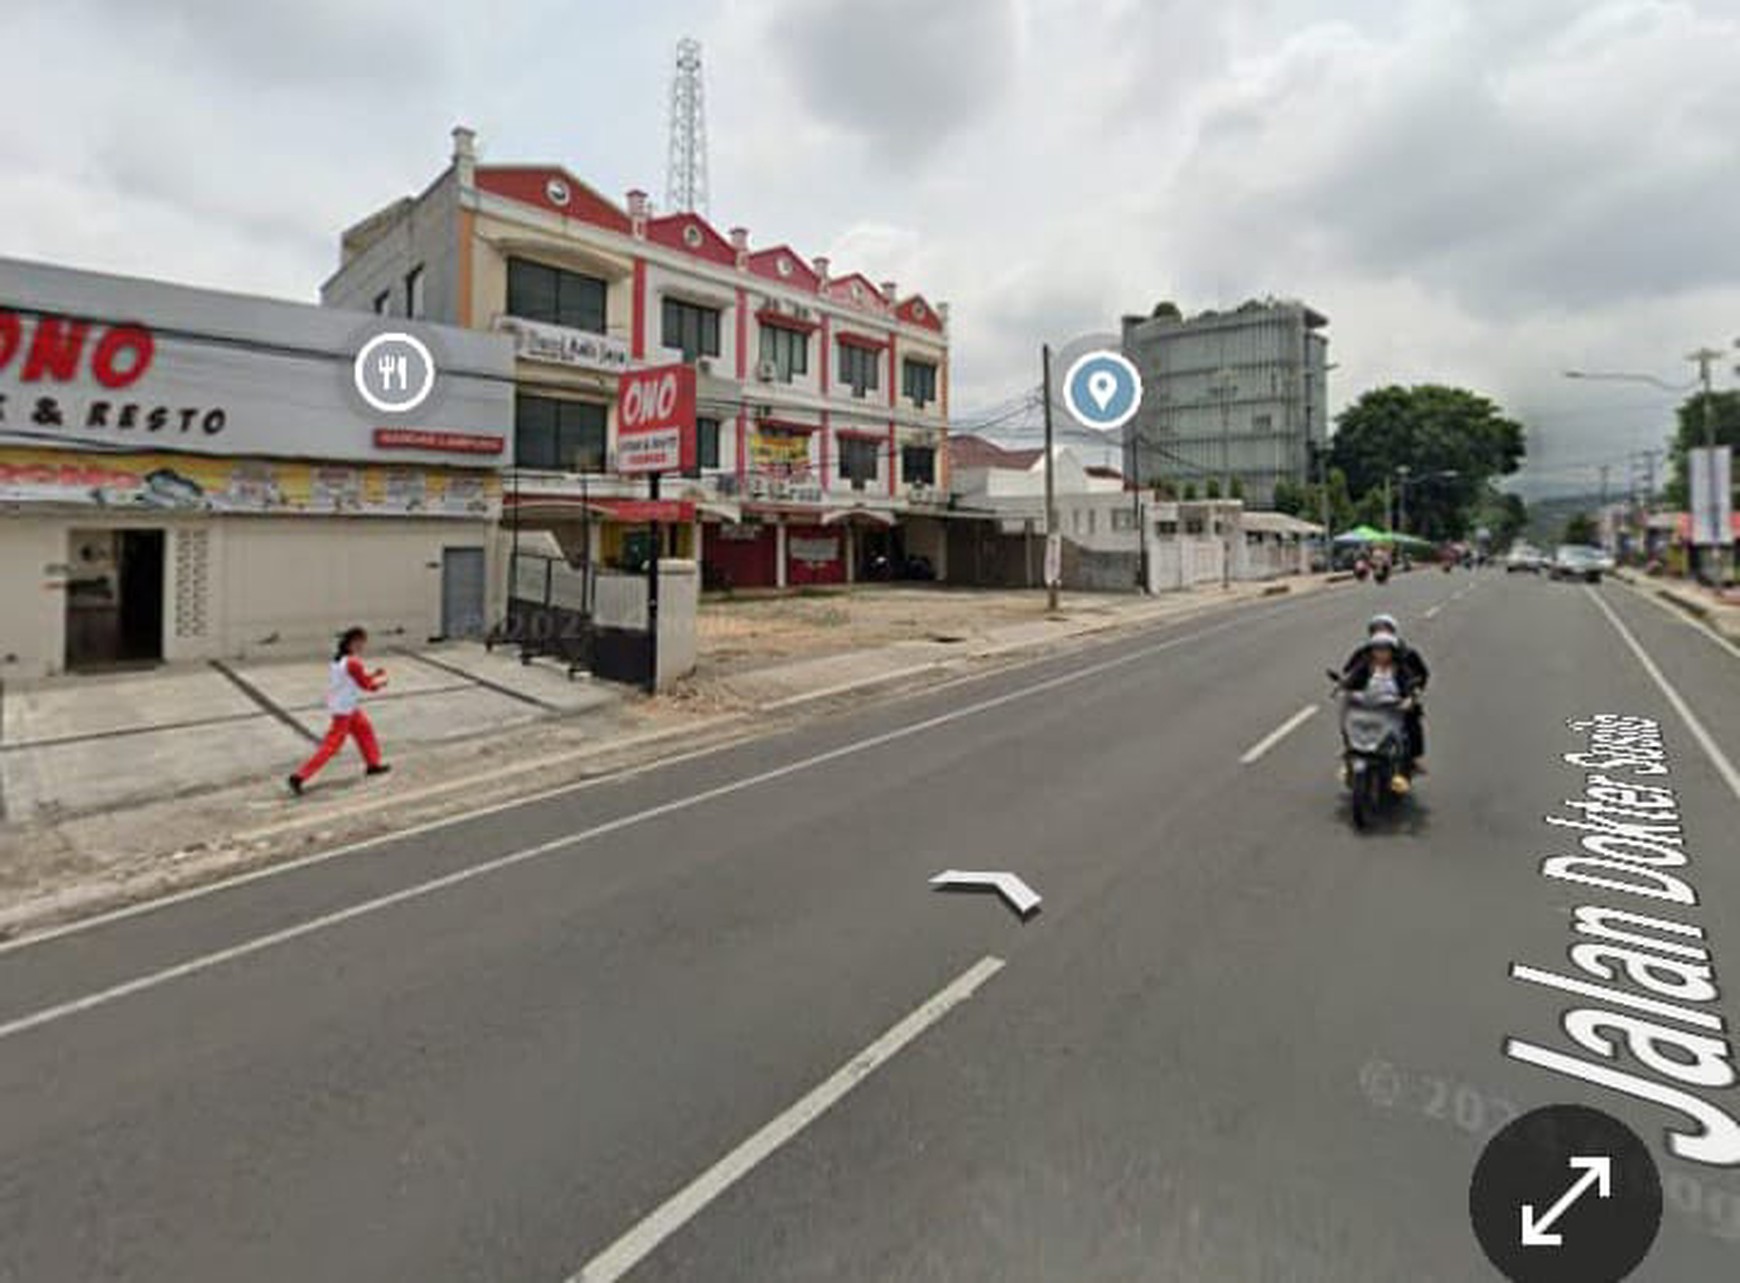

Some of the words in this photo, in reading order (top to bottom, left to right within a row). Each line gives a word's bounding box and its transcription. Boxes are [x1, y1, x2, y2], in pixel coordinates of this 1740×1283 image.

[31, 397, 63, 426] &
[86, 401, 227, 436] RESTO
[623, 371, 677, 427] ONO
